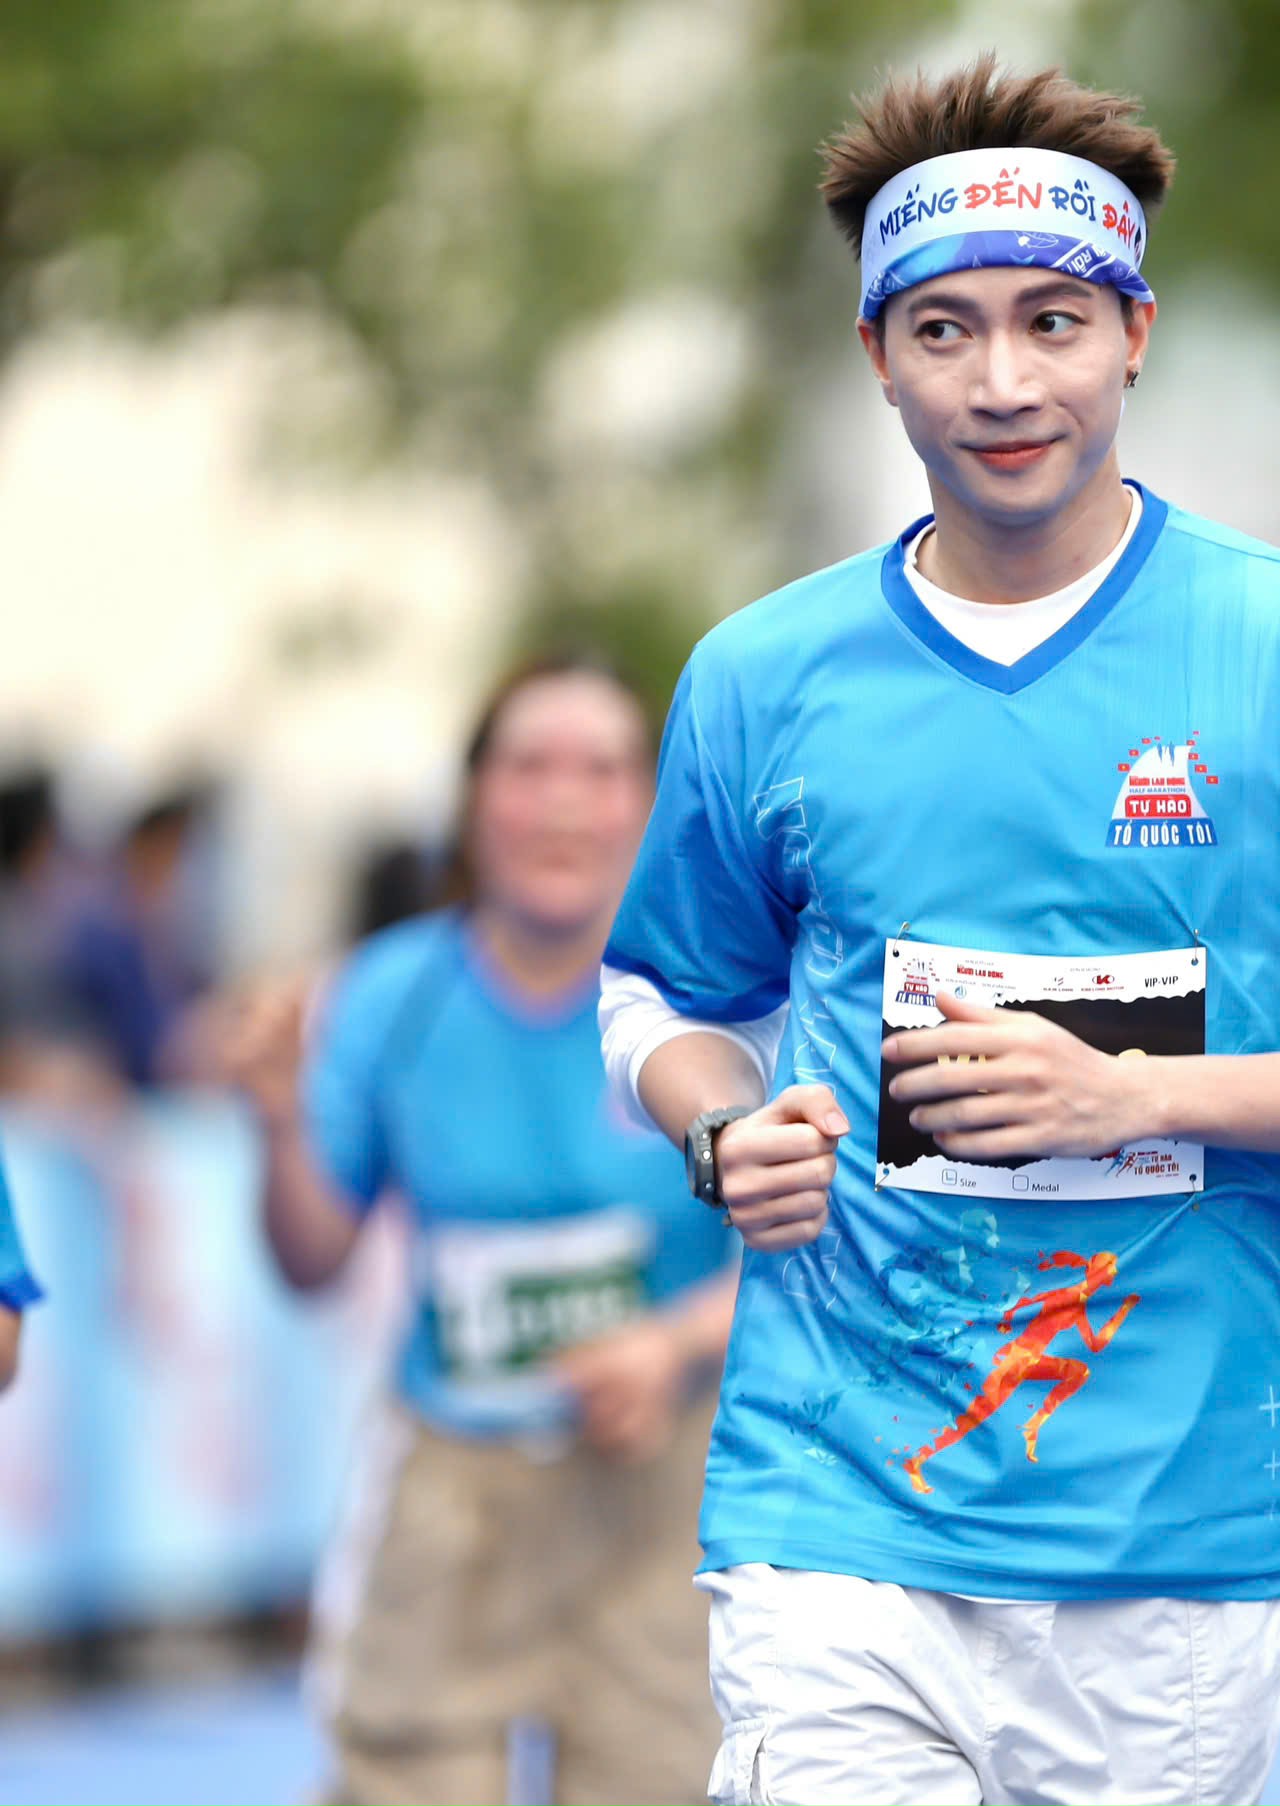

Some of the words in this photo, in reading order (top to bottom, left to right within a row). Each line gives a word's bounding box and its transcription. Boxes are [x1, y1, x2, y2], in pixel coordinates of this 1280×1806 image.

[880, 184, 958, 246] MIẾNG
[964, 167, 1042, 209] ĐẾN
[1048, 179, 1096, 221] RỒI
[1102, 200, 1136, 249] ĐÂY
[1130, 799, 1150, 817] TỰ
[1157, 796, 1187, 814] HÀO
[1113, 818, 1133, 846] TỔ
[1140, 820, 1180, 848] QUỐC
[1187, 820, 1213, 845] TÔI
[1144, 976, 1179, 988] VIP-VIP
[959, 1178, 977, 1188] Size
[1031, 1183, 1060, 1193] Medal
